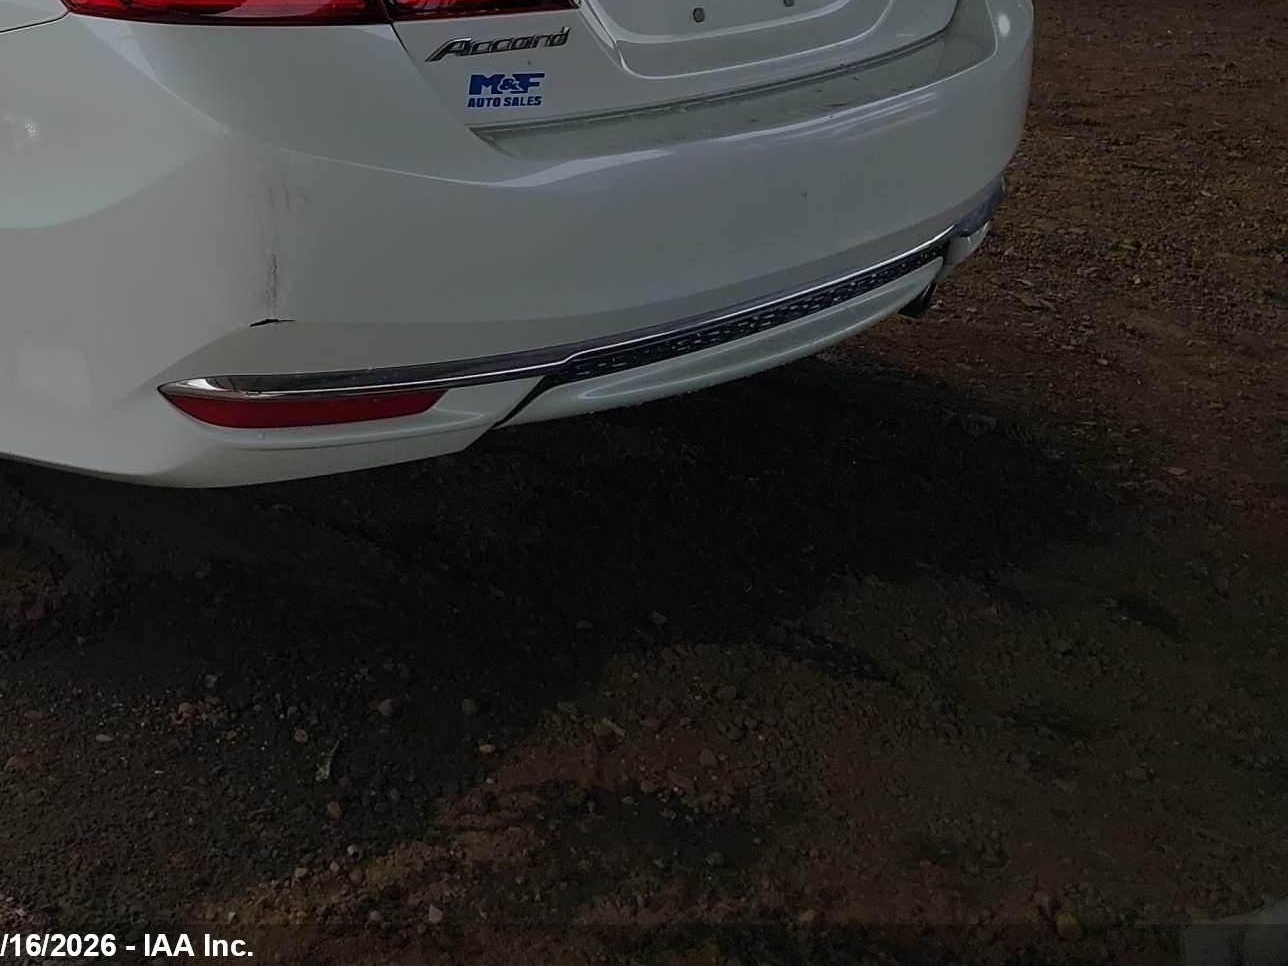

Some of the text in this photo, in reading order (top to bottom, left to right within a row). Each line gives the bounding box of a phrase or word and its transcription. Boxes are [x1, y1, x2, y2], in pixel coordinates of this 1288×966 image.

[425, 26, 571, 63] Accord
[468, 73, 546, 96] M&F
[467, 96, 542, 108] AUTO SALES
